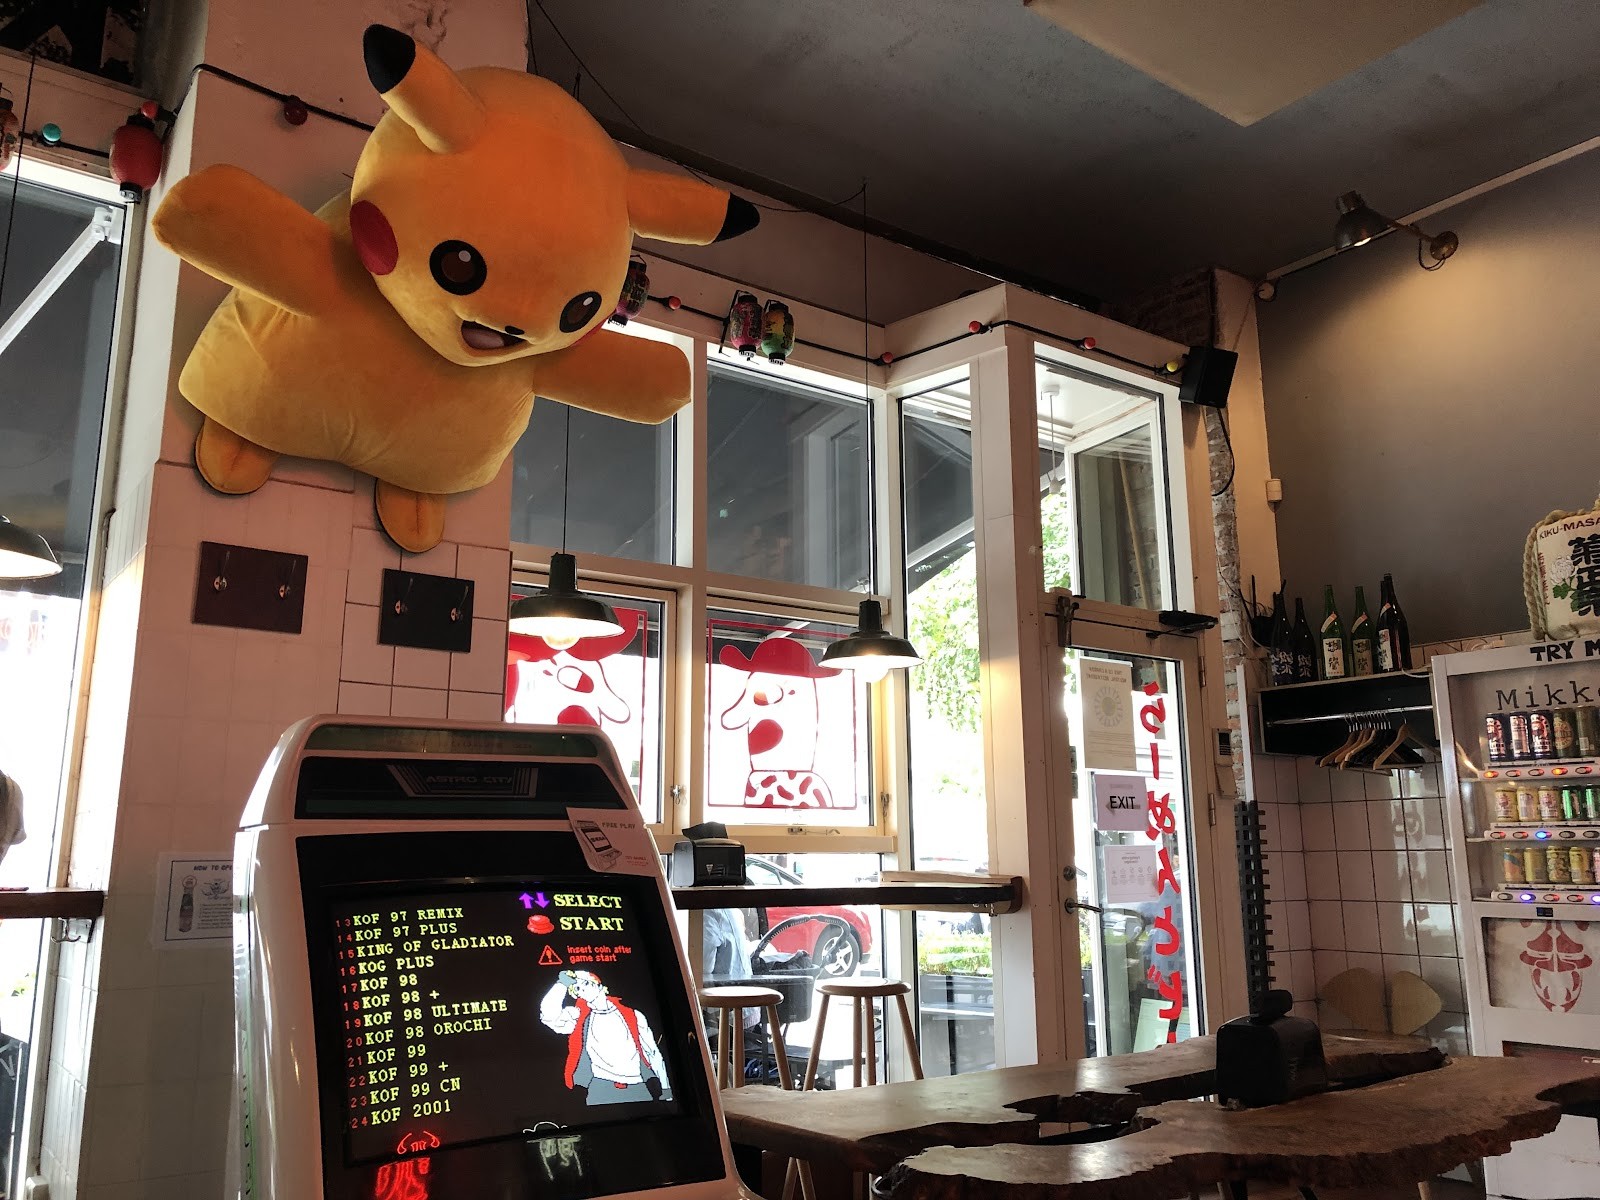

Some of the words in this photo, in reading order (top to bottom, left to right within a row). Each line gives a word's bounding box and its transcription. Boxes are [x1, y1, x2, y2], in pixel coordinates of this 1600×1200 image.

[1530, 640, 1575, 662] TRY
[1496, 680, 1600, 711] Mikk
[1109, 796, 1136, 810] EXIT
[553, 894, 622, 909] SELECT
[336, 918, 351, 928] 13
[353, 913, 380, 926] KOF
[390, 910, 408, 922] 97
[416, 907, 464, 921] REMIX
[559, 916, 624, 932] START
[337, 933, 353, 943] 14
[354, 928, 382, 942] KOF
[393, 925, 410, 938] 97
[419, 922, 458, 935] PLUS
[339, 949, 355, 960] 15
[356, 943, 394, 958] KING
[403, 940, 421, 953] OF
[431, 935, 515, 950] GLADIATOR
[566, 944, 592, 954] insert
[594, 944, 611, 954] coin
[614, 945, 632, 954] after
[340, 966, 356, 976] 16
[358, 960, 387, 974] KOG
[396, 955, 435, 970] PLUS
[569, 954, 593, 965] game
[596, 953, 617, 962] start
[342, 983, 358, 994] 17
[360, 976, 389, 992] KOF
[399, 974, 418, 987] 98
[343, 1000, 360, 1011] 18
[362, 994, 391, 1009] KOF
[401, 990, 420, 1004] 98
[345, 1018, 362, 1030] 19
[363, 1012, 393, 1027] KOF
[403, 1008, 423, 1021] 98
[431, 999, 508, 1018] ULTIMATE
[346, 1037, 363, 1048] 20
[365, 1029, 394, 1045] KOF
[405, 1025, 425, 1040] 98
[433, 1018, 492, 1036] OROCHI
[348, 1056, 363, 1068] 21
[366, 1048, 396, 1065] KOF
[407, 1043, 426, 1058] 99
[349, 1075, 366, 1088] 22
[368, 1067, 398, 1085] KOF
[409, 1062, 428, 1078] 99
[350, 1095, 368, 1108] 23
[369, 1087, 400, 1105] KOF
[411, 1082, 430, 1098] 99
[439, 1077, 461, 1093] CN
[351, 1116, 368, 1129] 24
[371, 1107, 401, 1125] KOF
[413, 1099, 451, 1117] 2001
